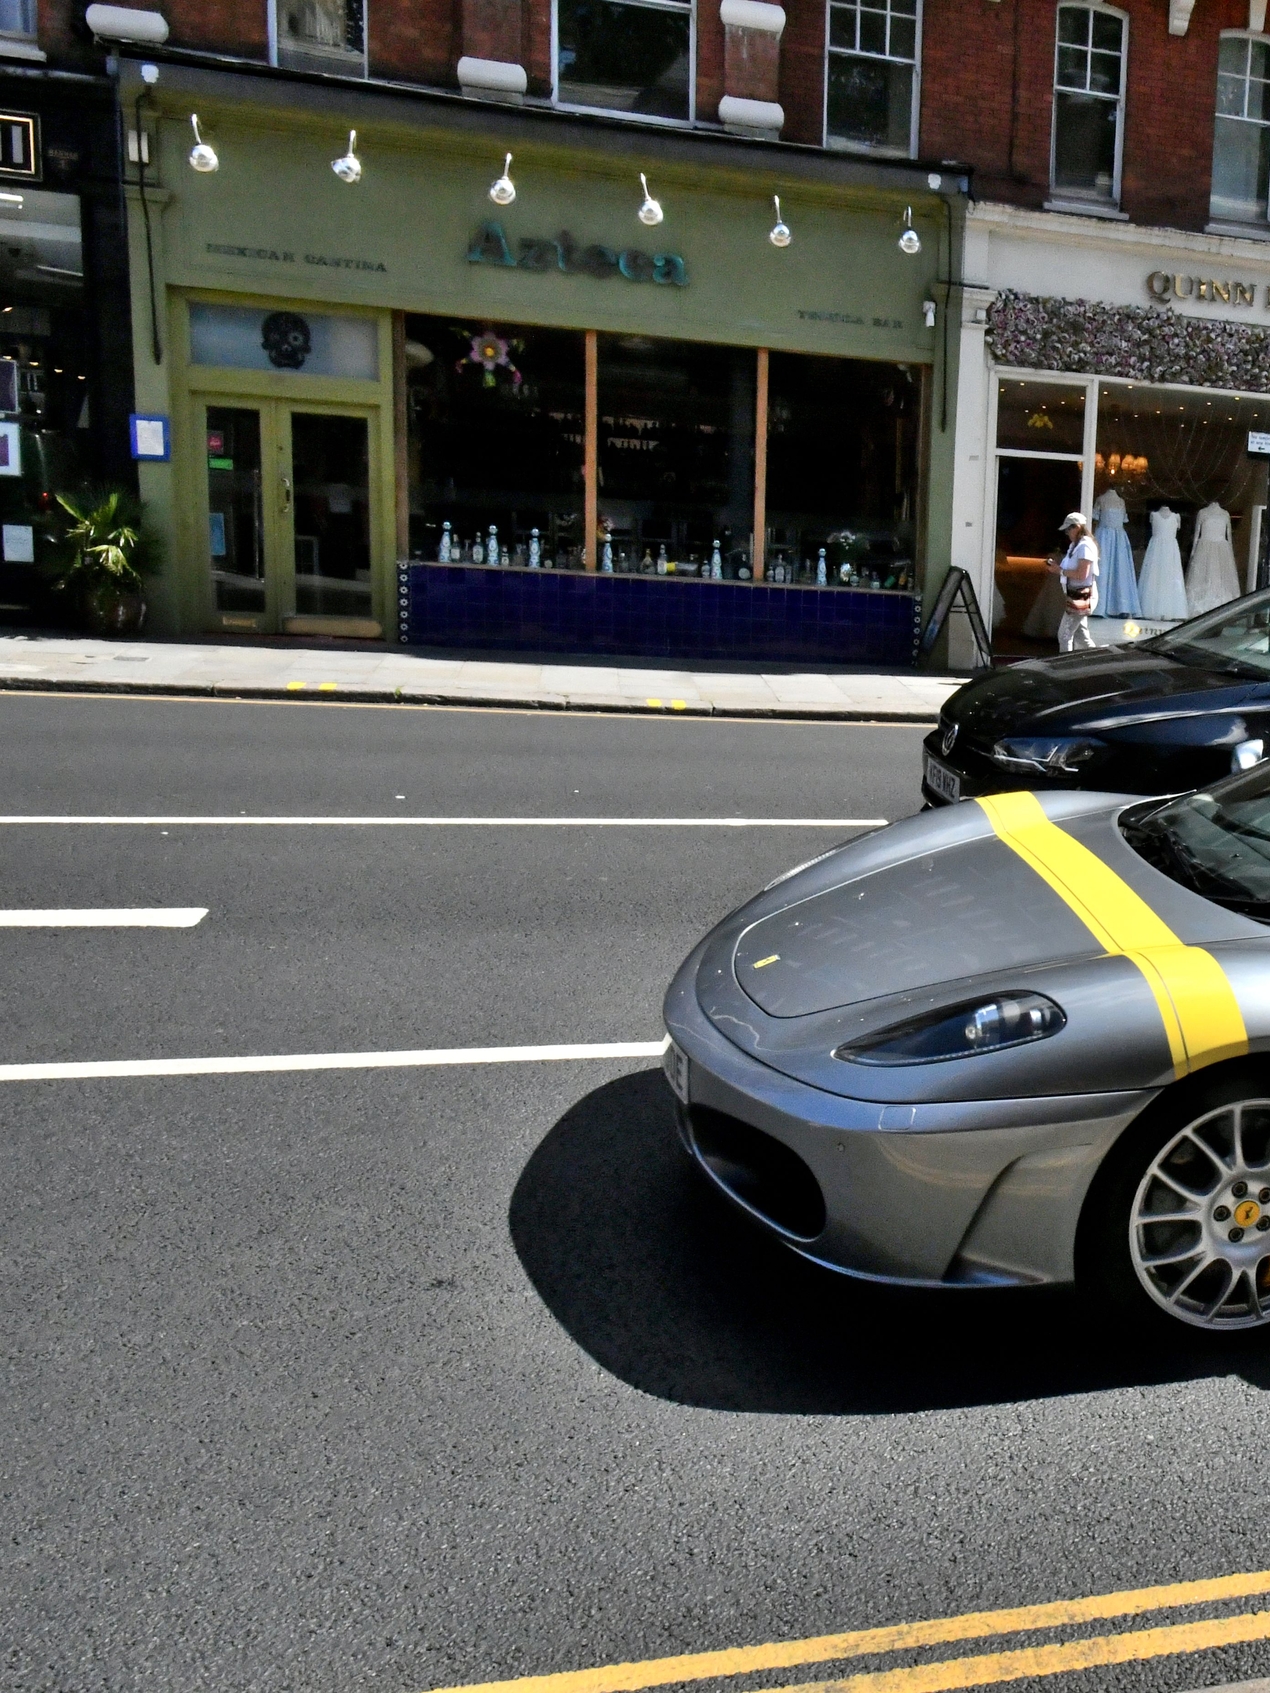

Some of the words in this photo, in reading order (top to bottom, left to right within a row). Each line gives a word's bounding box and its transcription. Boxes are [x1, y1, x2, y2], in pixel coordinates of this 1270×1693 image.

[304, 253, 387, 273] CANTINA
[467, 221, 689, 287] Azteca
[1147, 270, 1257, 307] QUINN
